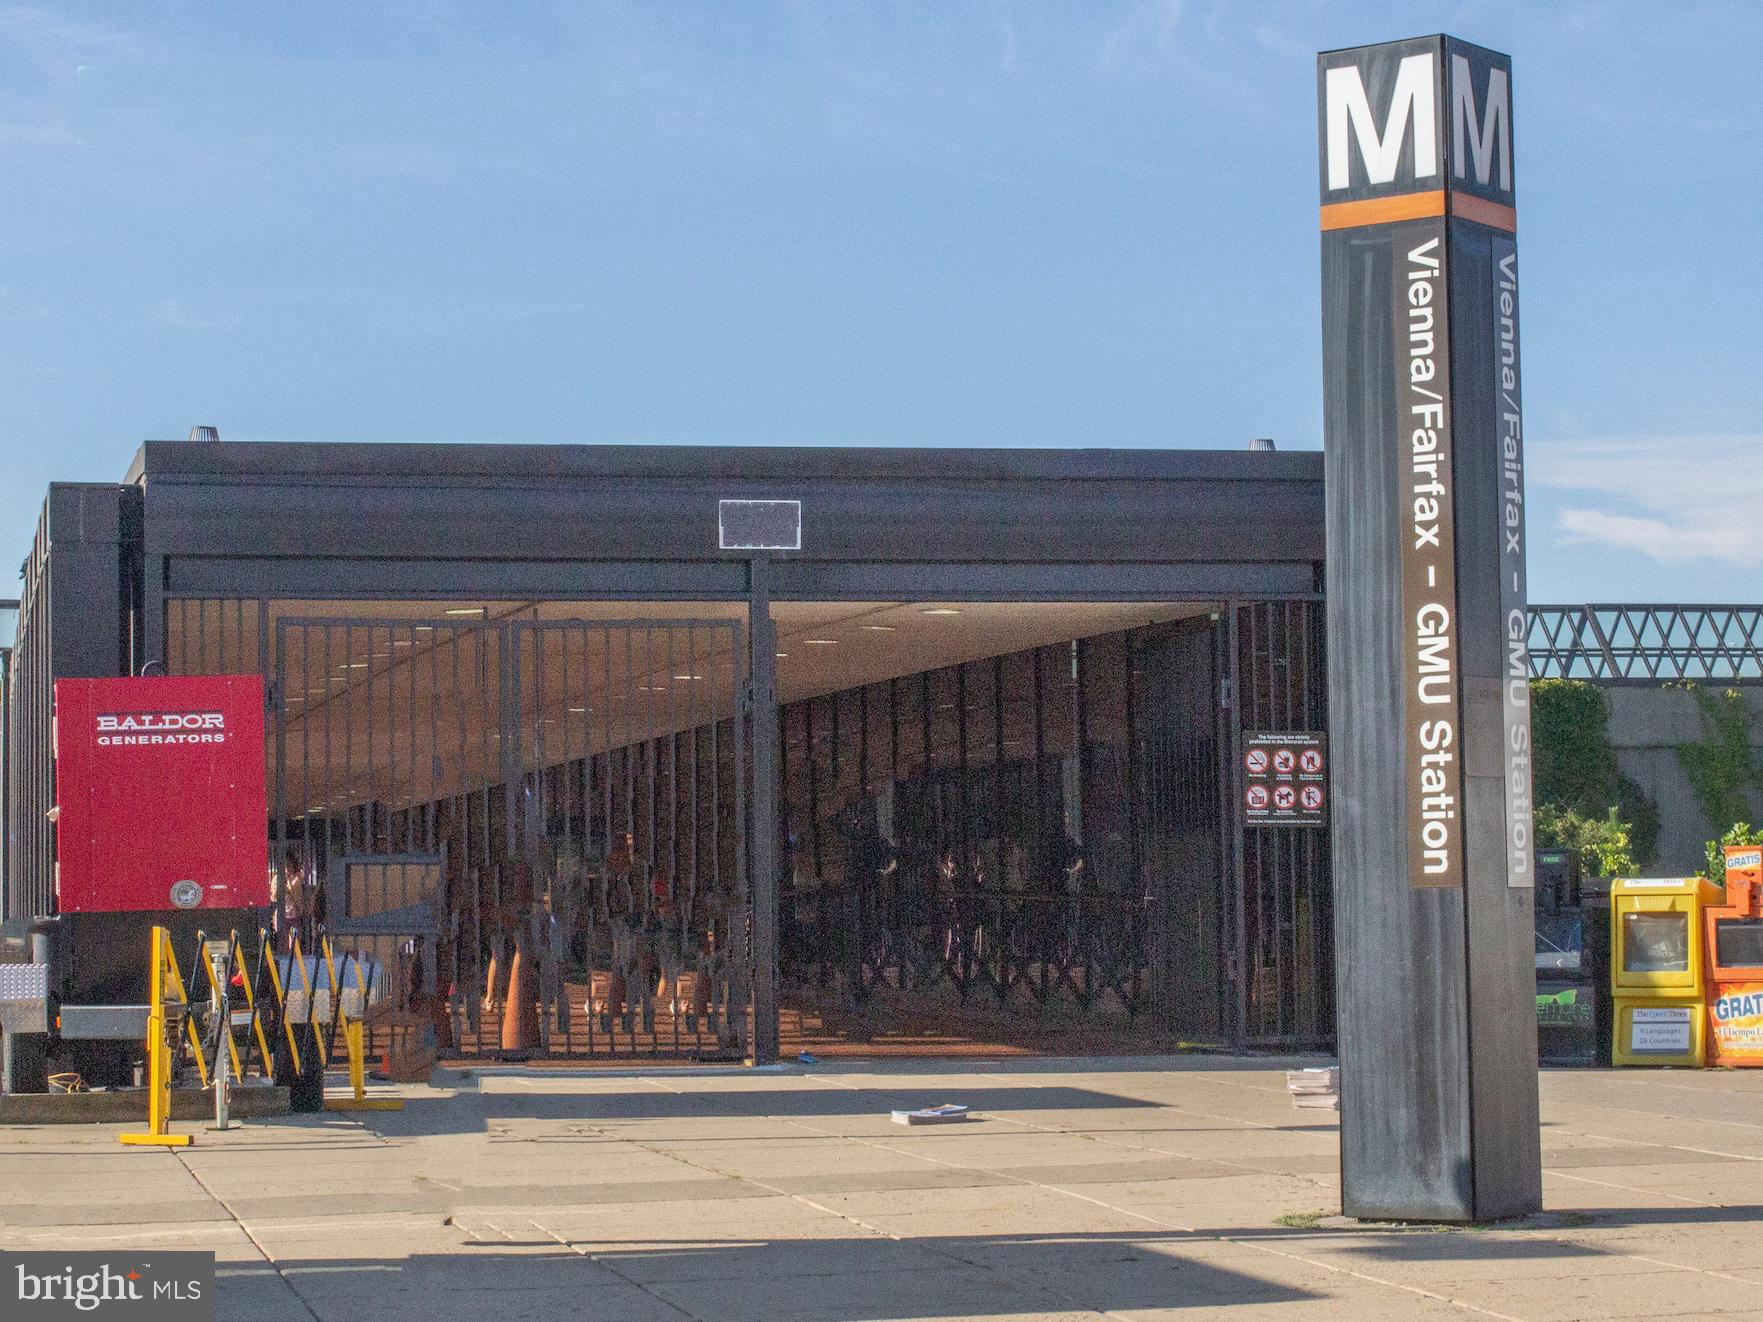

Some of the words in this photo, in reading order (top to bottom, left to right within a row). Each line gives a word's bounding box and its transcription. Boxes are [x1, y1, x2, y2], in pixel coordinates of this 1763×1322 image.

[1326, 53, 1436, 191] M
[1452, 53, 1511, 192] M
[1407, 237, 1445, 550] Vienna/Fairfax
[1499, 253, 1522, 554] Vienna/Fairfax
[1416, 603, 1451, 705] GMU
[1507, 608, 1527, 708] GMU
[96, 714, 225, 731] BALDOR
[97, 733, 225, 746] GENERATORS
[1419, 720, 1455, 874] Station
[1511, 724, 1530, 874] Station
[1727, 854, 1760, 868] GRATIS
[1636, 1010, 1649, 1018] The
[1669, 1010, 1688, 1018] Times
[1728, 1028, 1756, 1038] Tiempo
